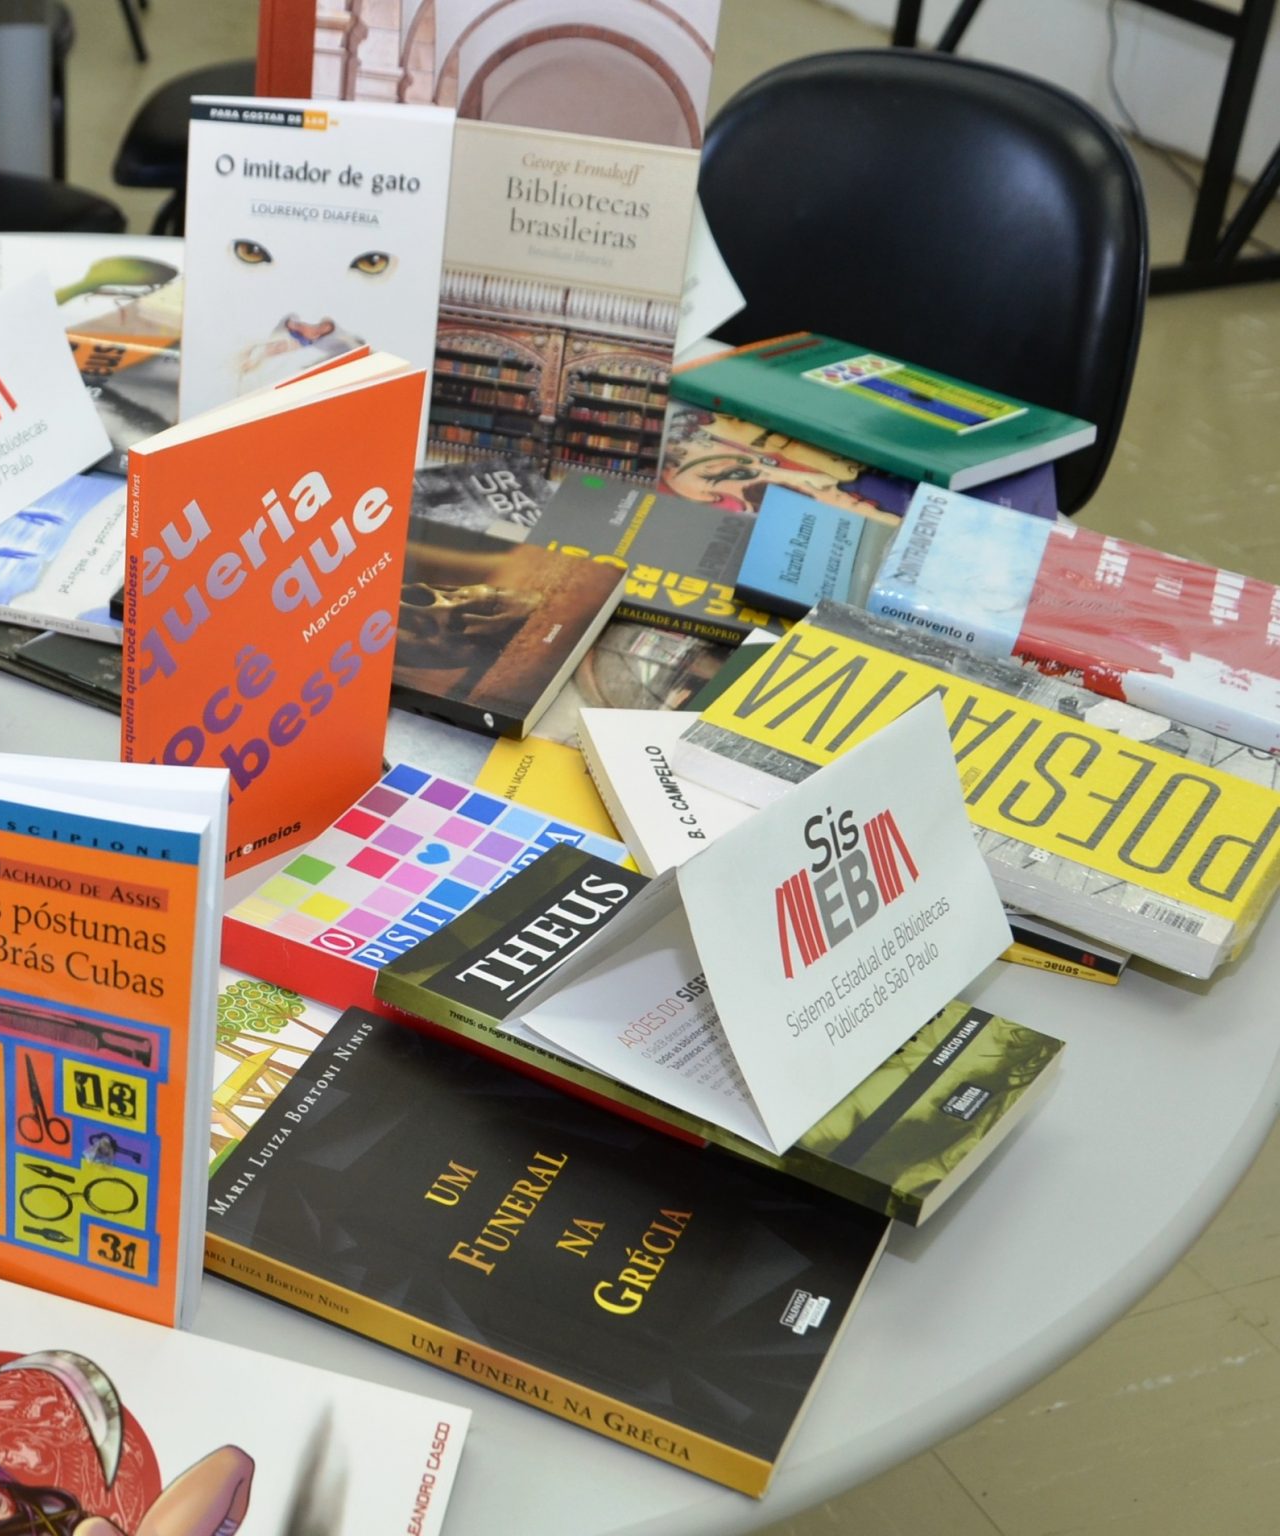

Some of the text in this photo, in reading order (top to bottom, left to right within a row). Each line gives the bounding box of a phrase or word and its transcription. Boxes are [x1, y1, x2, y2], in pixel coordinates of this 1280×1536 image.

[210, 108, 322, 125] PARA GOSTAR DE
[215, 153, 420, 195] O imitador de gato
[507, 175, 650, 219] Bibliotecas
[522, 159, 644, 186] George Ermakoff
[251, 203, 379, 224] LOURENÇO DIAFÉRIA
[510, 207, 637, 249] brasileiras
[0, 454, 34, 480] Paulo
[130, 474, 141, 538] Marcos Kirst
[142, 499, 212, 596] eu
[272, 486, 393, 613] que
[779, 512, 817, 585] Ricardo Ramos
[896, 505, 945, 585] CONTRAVENTO
[128, 555, 138, 624] soubesse
[140, 471, 333, 685] queria
[302, 551, 393, 643] Marcos Kirst
[127, 628, 136, 663] você
[617, 608, 740, 641] LEALDADE A SI PRÓPRIO
[881, 604, 975, 643] contravento 6
[127, 667, 136, 694] que
[220, 609, 396, 792] besse
[125, 698, 135, 744] queria
[148, 644, 277, 767] ocê
[514, 755, 535, 784] IACOCCA
[645, 745, 705, 840] B. C. CAMPELLO
[6, 819, 172, 860] SCIPIONE
[804, 806, 860, 874] Sis
[80, 882, 101, 898] DE
[110, 885, 162, 909] ASSIS
[13, 900, 168, 954] póstumas
[454, 873, 630, 992] THEUS
[65, 951, 165, 998] Cubas
[785, 895, 951, 1038] Sistema Estadual de Bibliotecas
[1043, 960, 1080, 977] senac
[824, 941, 939, 1046] Públicas de São Paulo
[448, 1009, 477, 1028] THEUS:
[477, 1022, 489, 1032] do
[488, 1026, 507, 1041] fogo
[616, 996, 687, 1048] AÇÕES DO
[933, 1018, 979, 1066] FABRÍCIO VIANA
[208, 1021, 374, 1216] MARIA LUIZA BORTONI NINIS
[424, 1159, 479, 1208] UM
[448, 1149, 569, 1276] FUNERAL
[97, 1232, 138, 1269] 31
[555, 1217, 607, 1258] NA
[593, 1204, 694, 1316] GRÉCIA
[203, 1248, 351, 1316] ARIA LUIZA BORTONI NINIS
[783, 1291, 809, 1325] TALENTOS
[410, 1334, 691, 1462] UM FUNERAL NA GRÉCIA
[427, 1421, 451, 1470] CASCO
